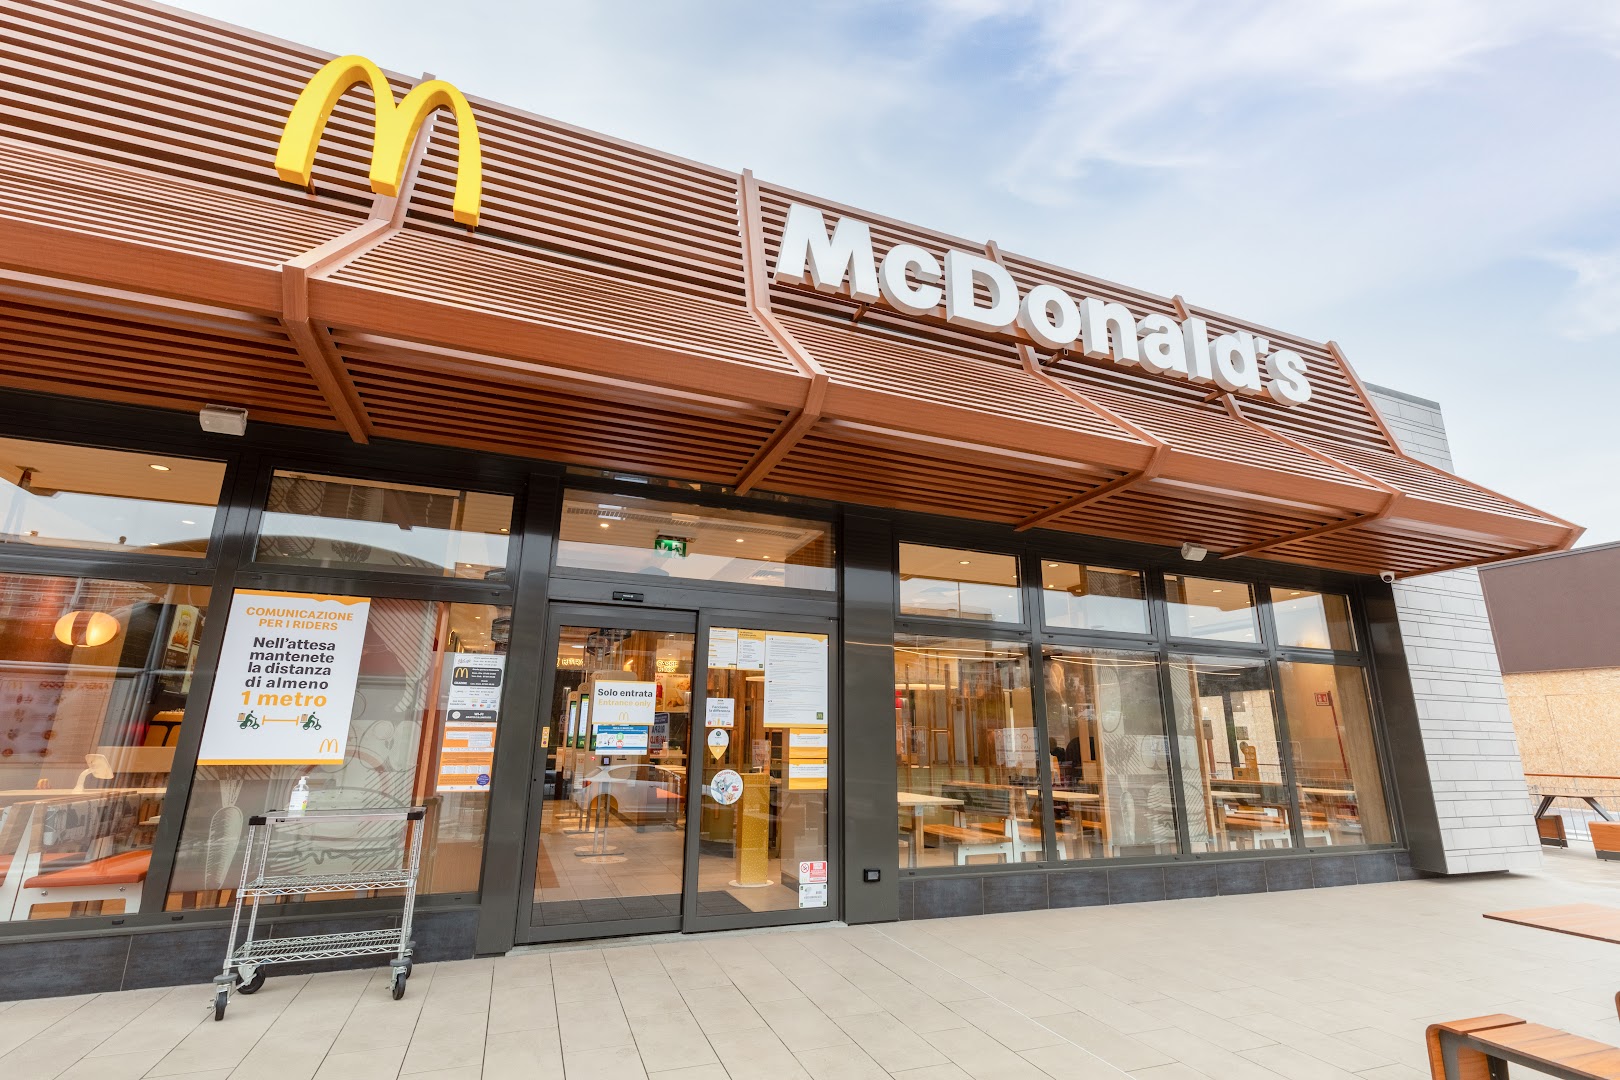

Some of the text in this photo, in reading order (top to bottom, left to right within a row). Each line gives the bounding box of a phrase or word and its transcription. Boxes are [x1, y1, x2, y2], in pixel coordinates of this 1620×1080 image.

[775, 203, 1312, 406] McDonald's
[246, 607, 354, 621] COMUNICAZIONE
[258, 618, 338, 631] PER I RIDERS
[253, 636, 336, 651] Nell’attesa
[249, 650, 335, 663] mantenete
[247, 662, 331, 676] la distanza
[244, 676, 329, 690] di almeno
[241, 690, 327, 707] 1 metro
[597, 688, 653, 698] Solo entrata
[635, 700, 651, 708] only
